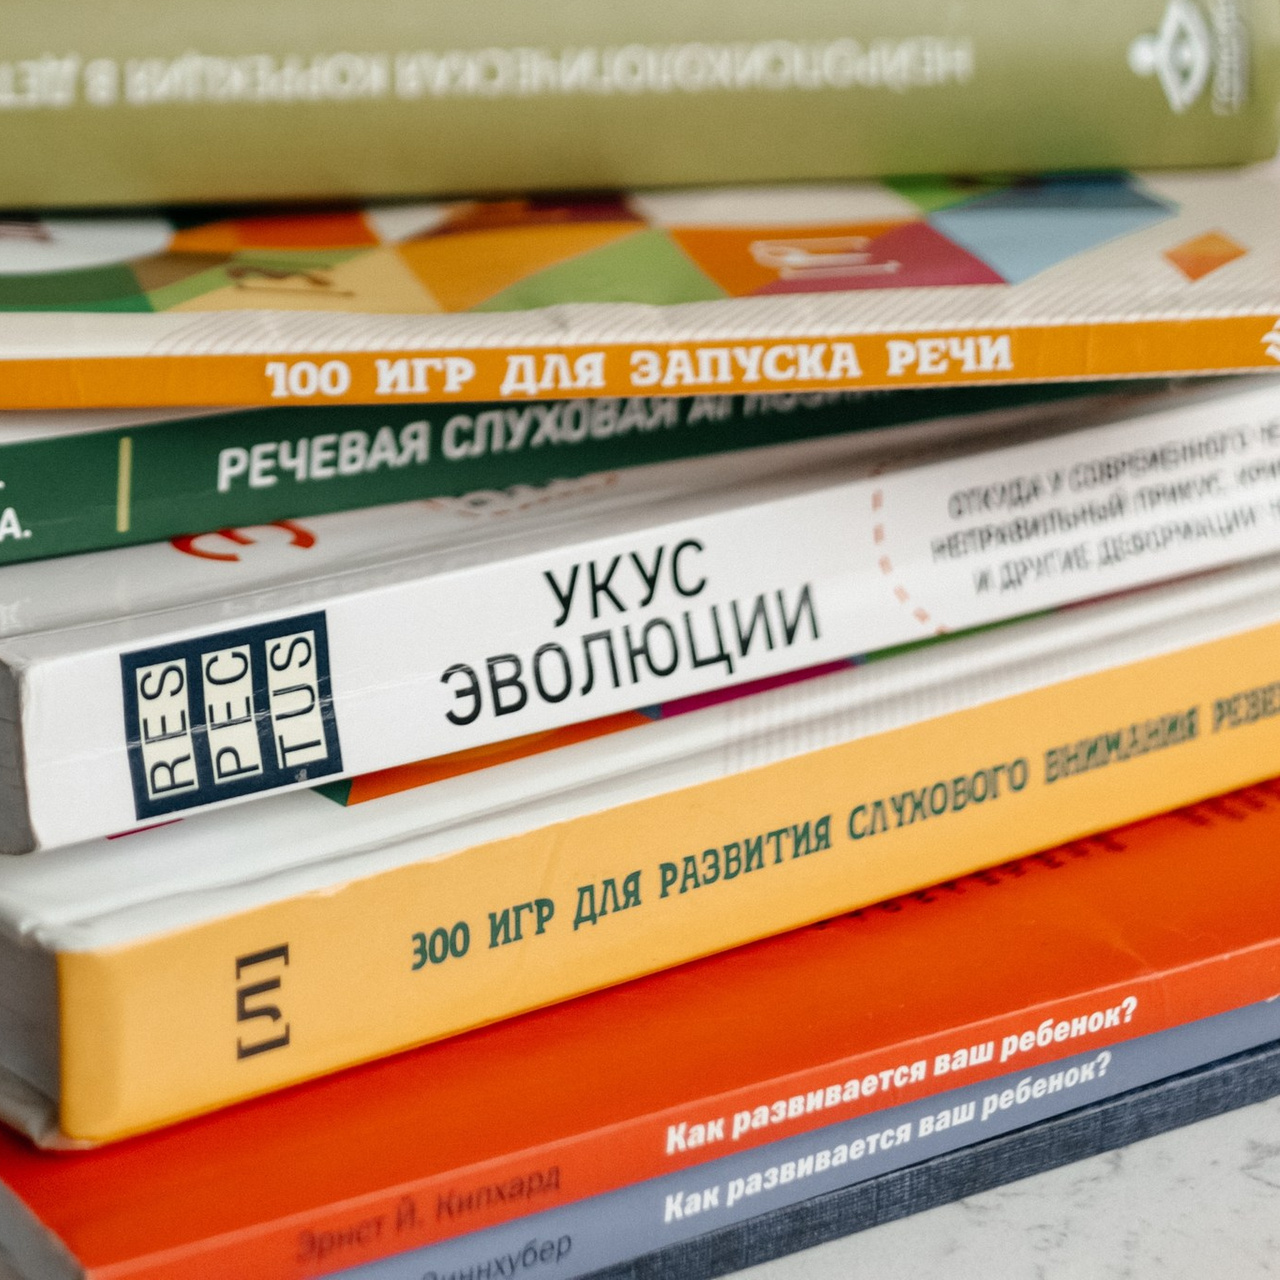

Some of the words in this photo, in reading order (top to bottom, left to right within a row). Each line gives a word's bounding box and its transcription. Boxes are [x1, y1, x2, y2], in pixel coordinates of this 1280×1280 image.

[265, 358, 351, 398] 100
[375, 354, 476, 395] ИГР
[500, 351, 607, 396] ДЛЯ
[630, 344, 863, 388] ЗАПУСКА
[886, 334, 1014, 376] РЕЧИ
[218, 419, 429, 493] РЕЧЕВАЯ
[441, 395, 678, 460] СЛУХОВАЯ
[544, 538, 707, 628] УКУС
[205, 650, 260, 780] PEC
[270, 636, 322, 769] TUS
[439, 583, 820, 727] ЭВОЛЮЦИИ
[139, 664, 195, 795] RES
[412, 921, 470, 971] 300
[488, 897, 556, 950] ИГР
[573, 870, 642, 931] ДЛЯ
[658, 814, 832, 899] РАЗВИТИЯ
[848, 756, 1030, 841] СЛУХОВОГО
[1043, 706, 1200, 785] ВНИМАНИЯ
[664, 1184, 720, 1225] Как
[725, 1121, 912, 1210] развивается
[917, 1104, 976, 1140] ваш
[981, 1049, 1113, 1123] ребенок?
[666, 1116, 725, 1156] Как
[732, 1059, 926, 1143] развивается
[933, 1040, 995, 1077] ваш
[999, 995, 1139, 1062] ребенок?
[434, 1163, 563, 1222] Кипхард
